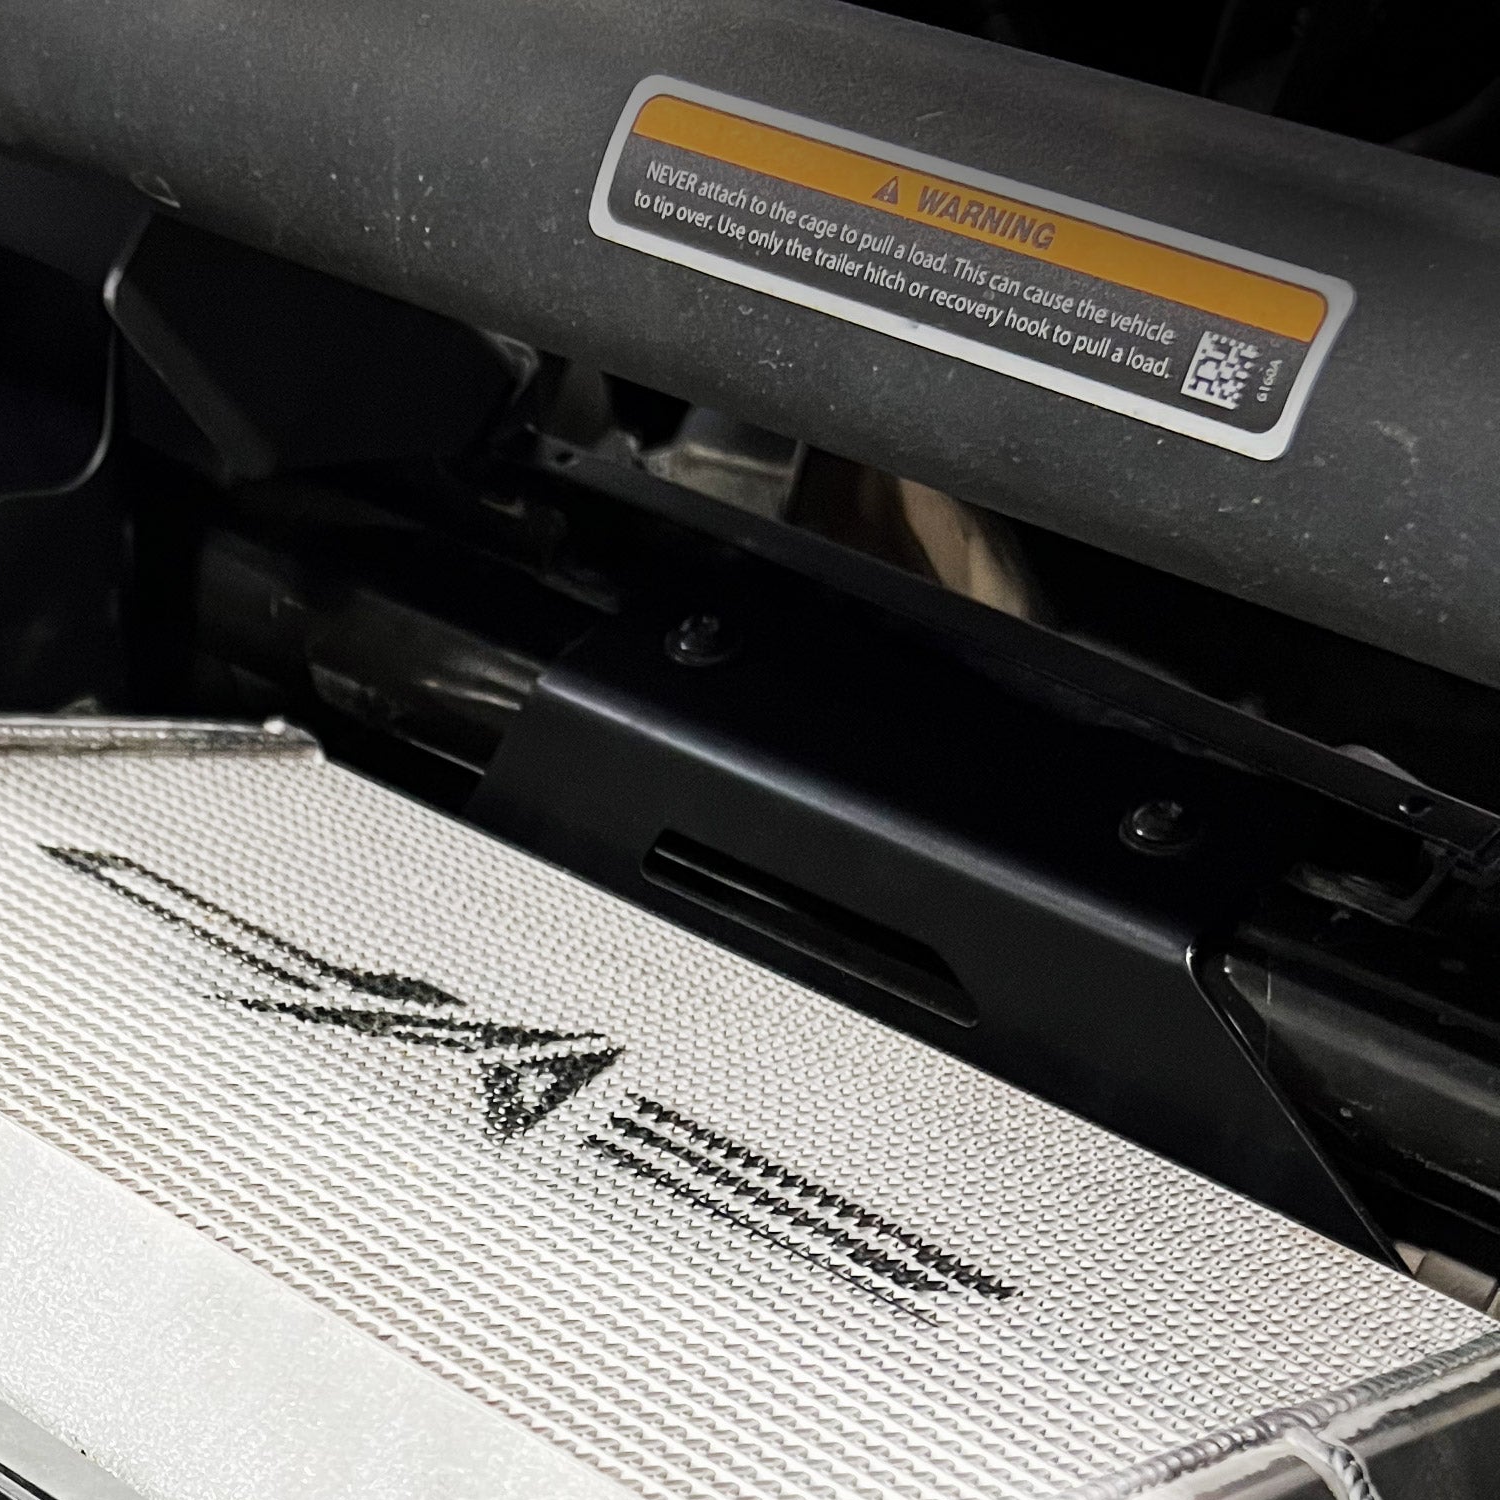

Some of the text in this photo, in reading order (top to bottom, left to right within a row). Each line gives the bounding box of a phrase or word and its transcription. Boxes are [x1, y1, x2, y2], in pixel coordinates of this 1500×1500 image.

[633, 188, 1171, 379] to tip over. Use only the trailer hitch or recovery hook to pull a load.
[646, 160, 1175, 346] NEVER attach to the cage to pull a load. This can cause the vehicle
[918, 186, 1056, 249] WARNING
